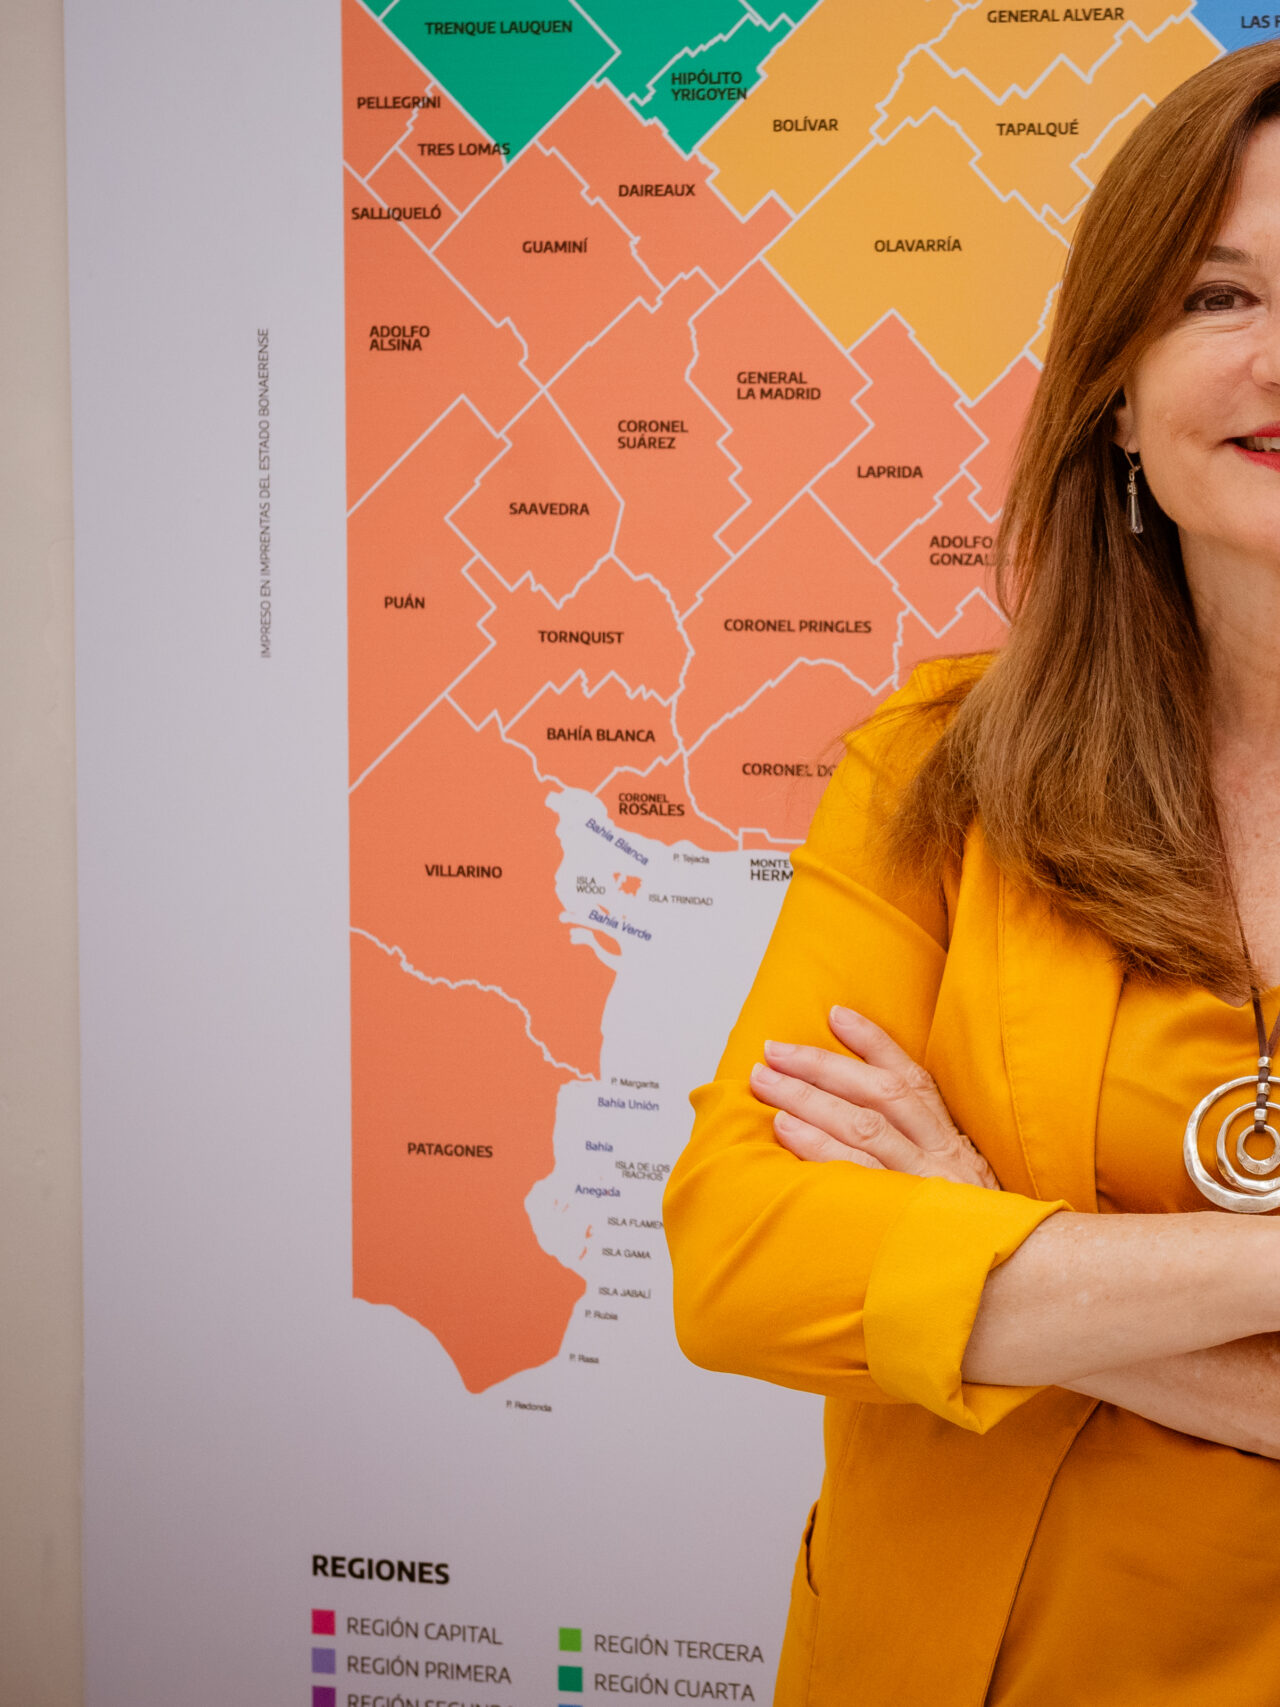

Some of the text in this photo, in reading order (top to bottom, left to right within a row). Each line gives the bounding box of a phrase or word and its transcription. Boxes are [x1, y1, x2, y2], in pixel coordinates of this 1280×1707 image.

[987, 7, 1125, 23] GENERAL ALVEAR
[1240, 15, 1271, 29] LAS
[425, 20, 573, 36] TRENQUE LAUQUEN
[671, 69, 743, 86] HIPÓLITO
[671, 87, 747, 101] YRIGOYEN
[356, 96, 441, 110] PELLEGRINI
[773, 116, 839, 132] BOLÍVAR
[997, 118, 1079, 137] TAPALQUÉ
[418, 143, 511, 156] TRES LOMAS
[618, 183, 696, 197] DAIREAUX
[351, 204, 442, 221] SALLIQUELÓ
[522, 237, 588, 254] GUAMINÍ
[874, 238, 962, 254] OLAVARRÍA
[369, 325, 431, 338] ADOLFO
[369, 338, 423, 352] ALSINA
[736, 371, 808, 385] GENERAL
[736, 387, 822, 400] LA MADRID
[617, 420, 688, 433] CORONEL
[617, 433, 677, 450] SUÁREZ
[857, 466, 923, 479] LAPRIDA
[257, 328, 272, 659] IMPRESO EN IMPRENTAS DEL ESTADO BONAERENSE
[509, 503, 590, 516] SAAVEDRA
[930, 535, 993, 549] ADOLFO
[384, 593, 426, 609] PUÁN
[724, 619, 872, 633] CORONEL PRINGLES
[538, 630, 625, 645] TORNQUIST
[547, 725, 656, 742] BAHÍA BLANCA
[742, 763, 812, 777] CORONEL
[618, 792, 670, 803] CORONEL
[618, 803, 685, 817] ROSALES
[584, 817, 649, 866] Bahía Blanca
[673, 853, 710, 865] P. Tejada
[750, 858, 789, 868] MONTE
[425, 864, 503, 879] VILLARINO
[750, 869, 793, 881] HERM
[576, 876, 597, 885] ISLA
[576, 886, 606, 895] WOOD
[649, 894, 713, 906] ISLA TRINIDAD
[588, 909, 652, 942] Bahía Verde
[597, 1097, 660, 1112] Bahía Unión
[407, 1142, 494, 1158] PATAGONES
[585, 1141, 614, 1153] Bahía
[615, 1160, 635, 1171] ISLA
[637, 1162, 650, 1172] DE
[575, 1184, 621, 1199] Anegada
[607, 1216, 664, 1229] ISLA FLAMEN
[602, 1247, 651, 1260] ISLA GAMA
[311, 1555, 450, 1584] REGIONES
[346, 1616, 503, 1645] REGIÓN CAPITAL
[594, 1633, 765, 1664] REGIÓN TERCERA
[346, 1656, 512, 1685] REGIÓN PRIMERA
[594, 1673, 756, 1702] REGIÓN CUARTA
